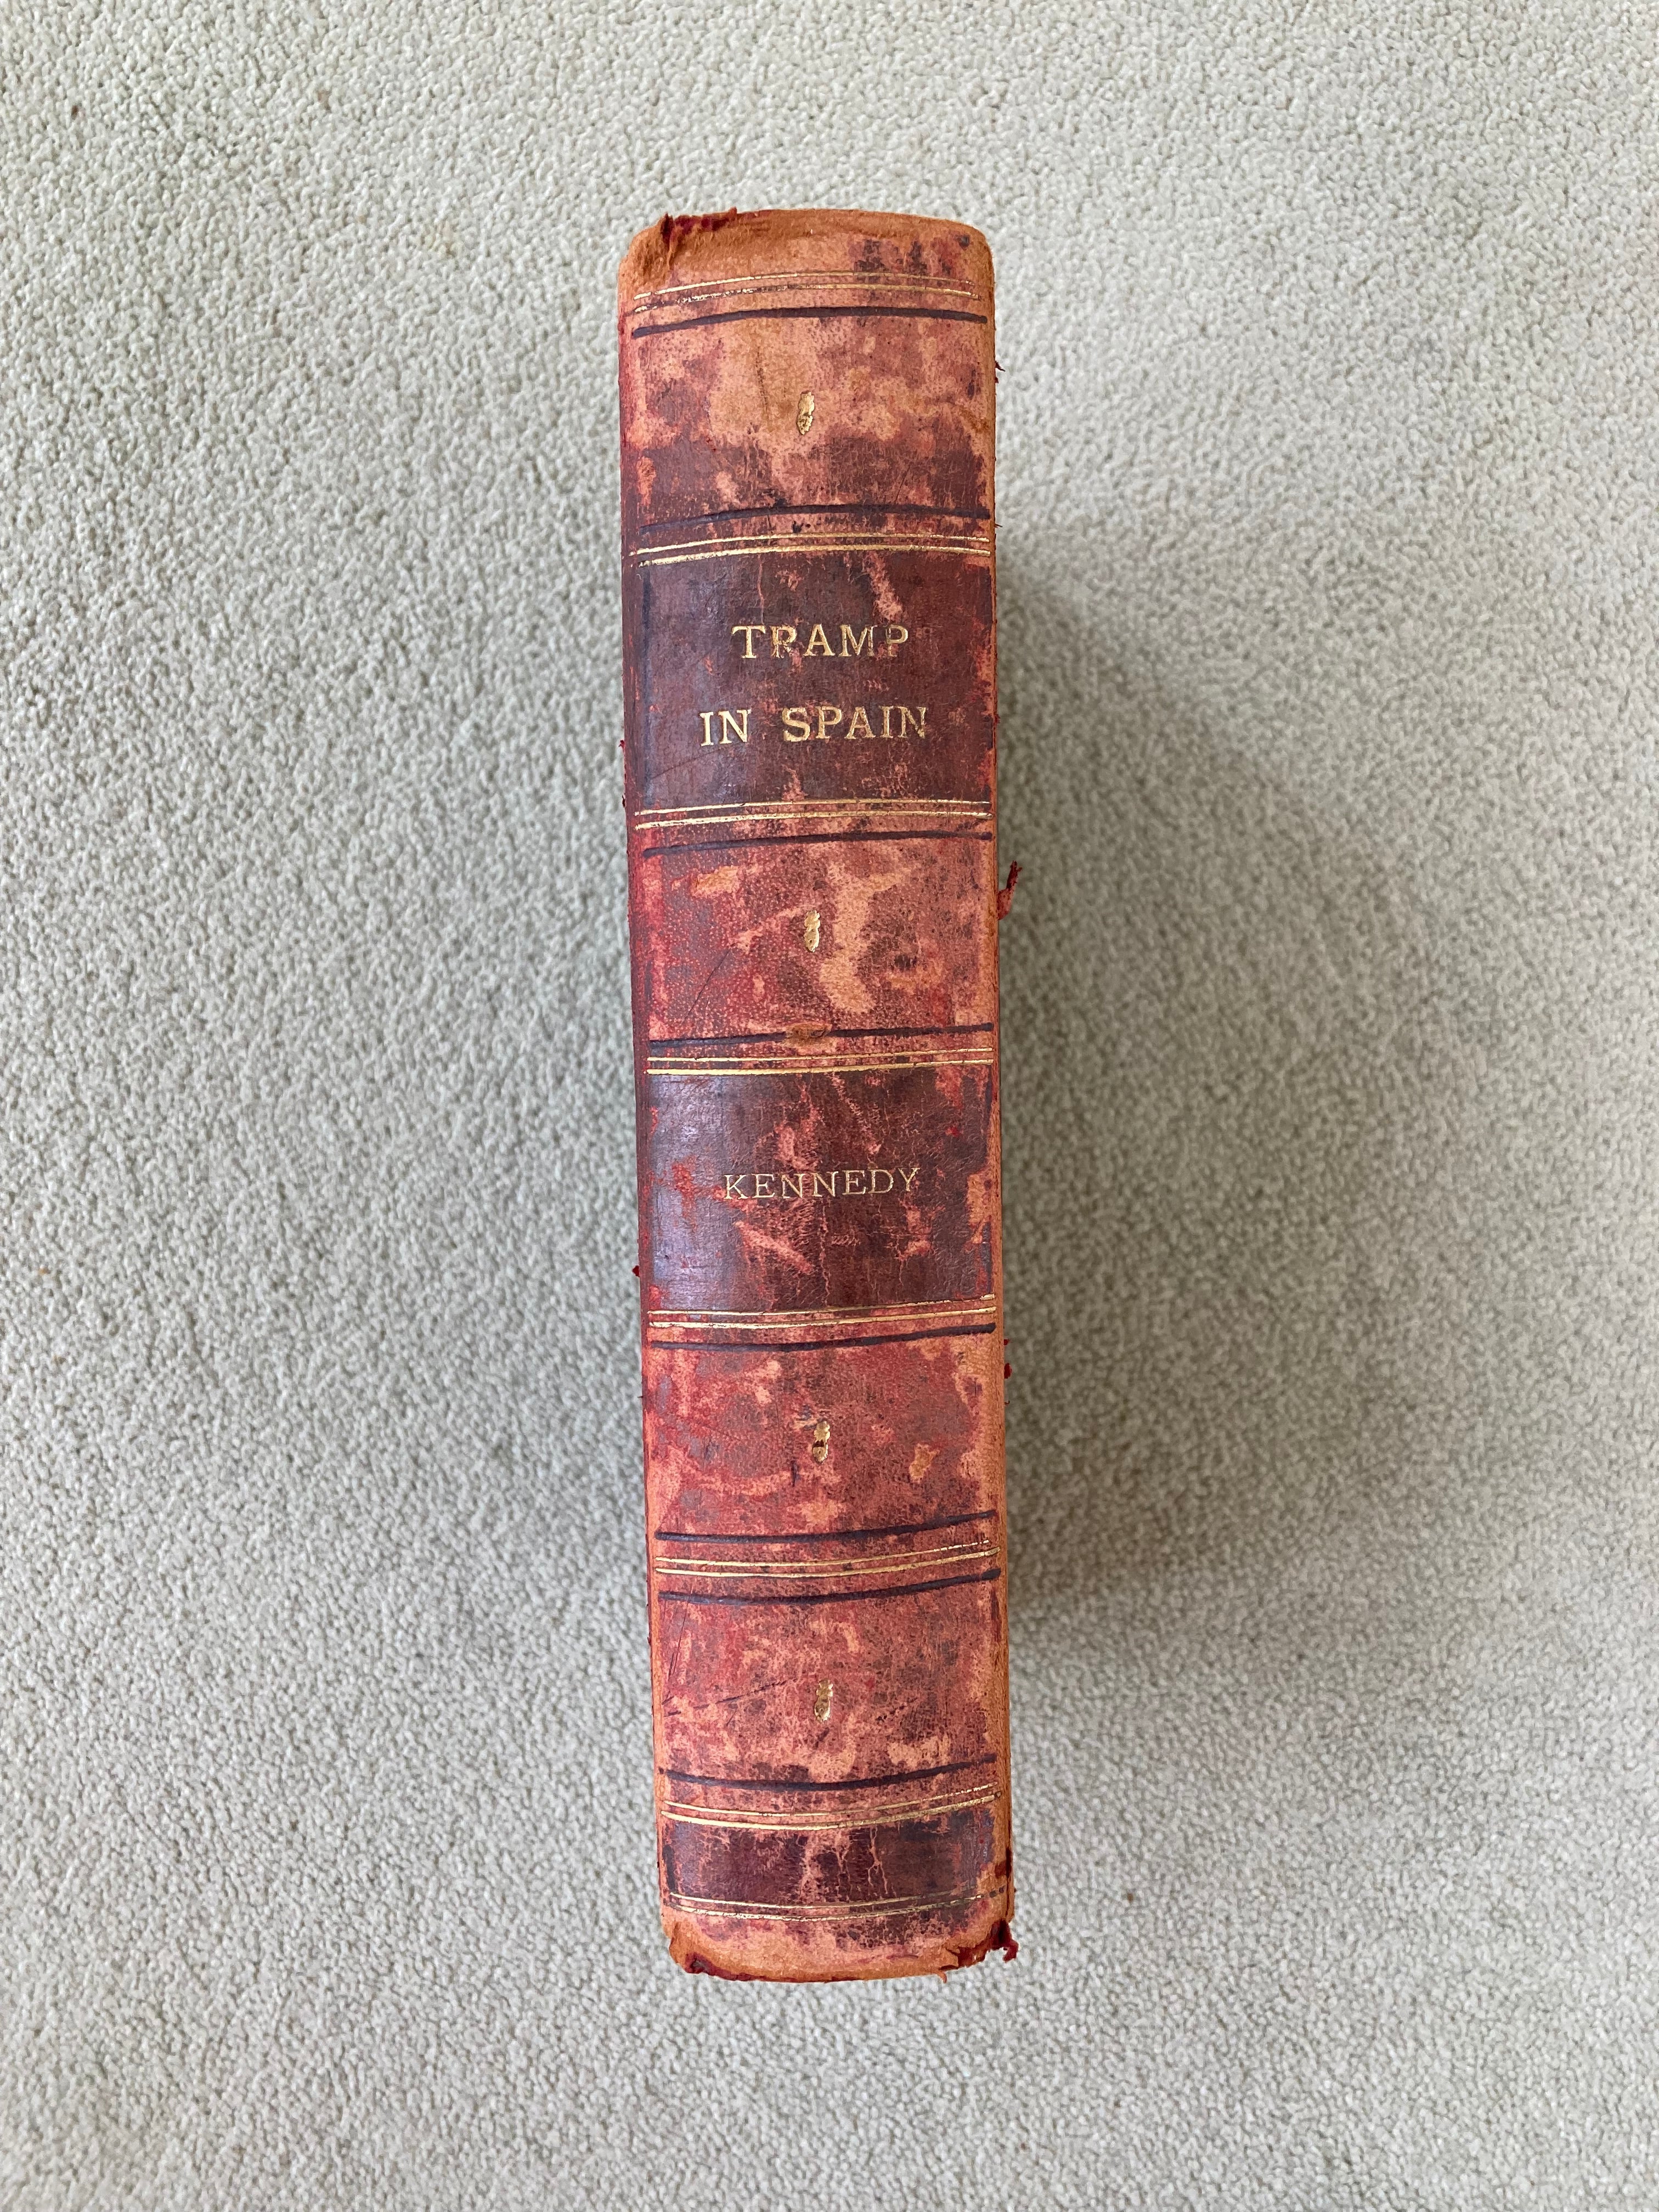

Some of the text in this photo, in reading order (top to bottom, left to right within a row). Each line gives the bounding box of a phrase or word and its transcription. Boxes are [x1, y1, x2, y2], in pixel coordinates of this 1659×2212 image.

[731, 624, 909, 658] TRAMP
[699, 706, 928, 746] IN SPAIN
[724, 1167, 921, 1200] KENNEDY
